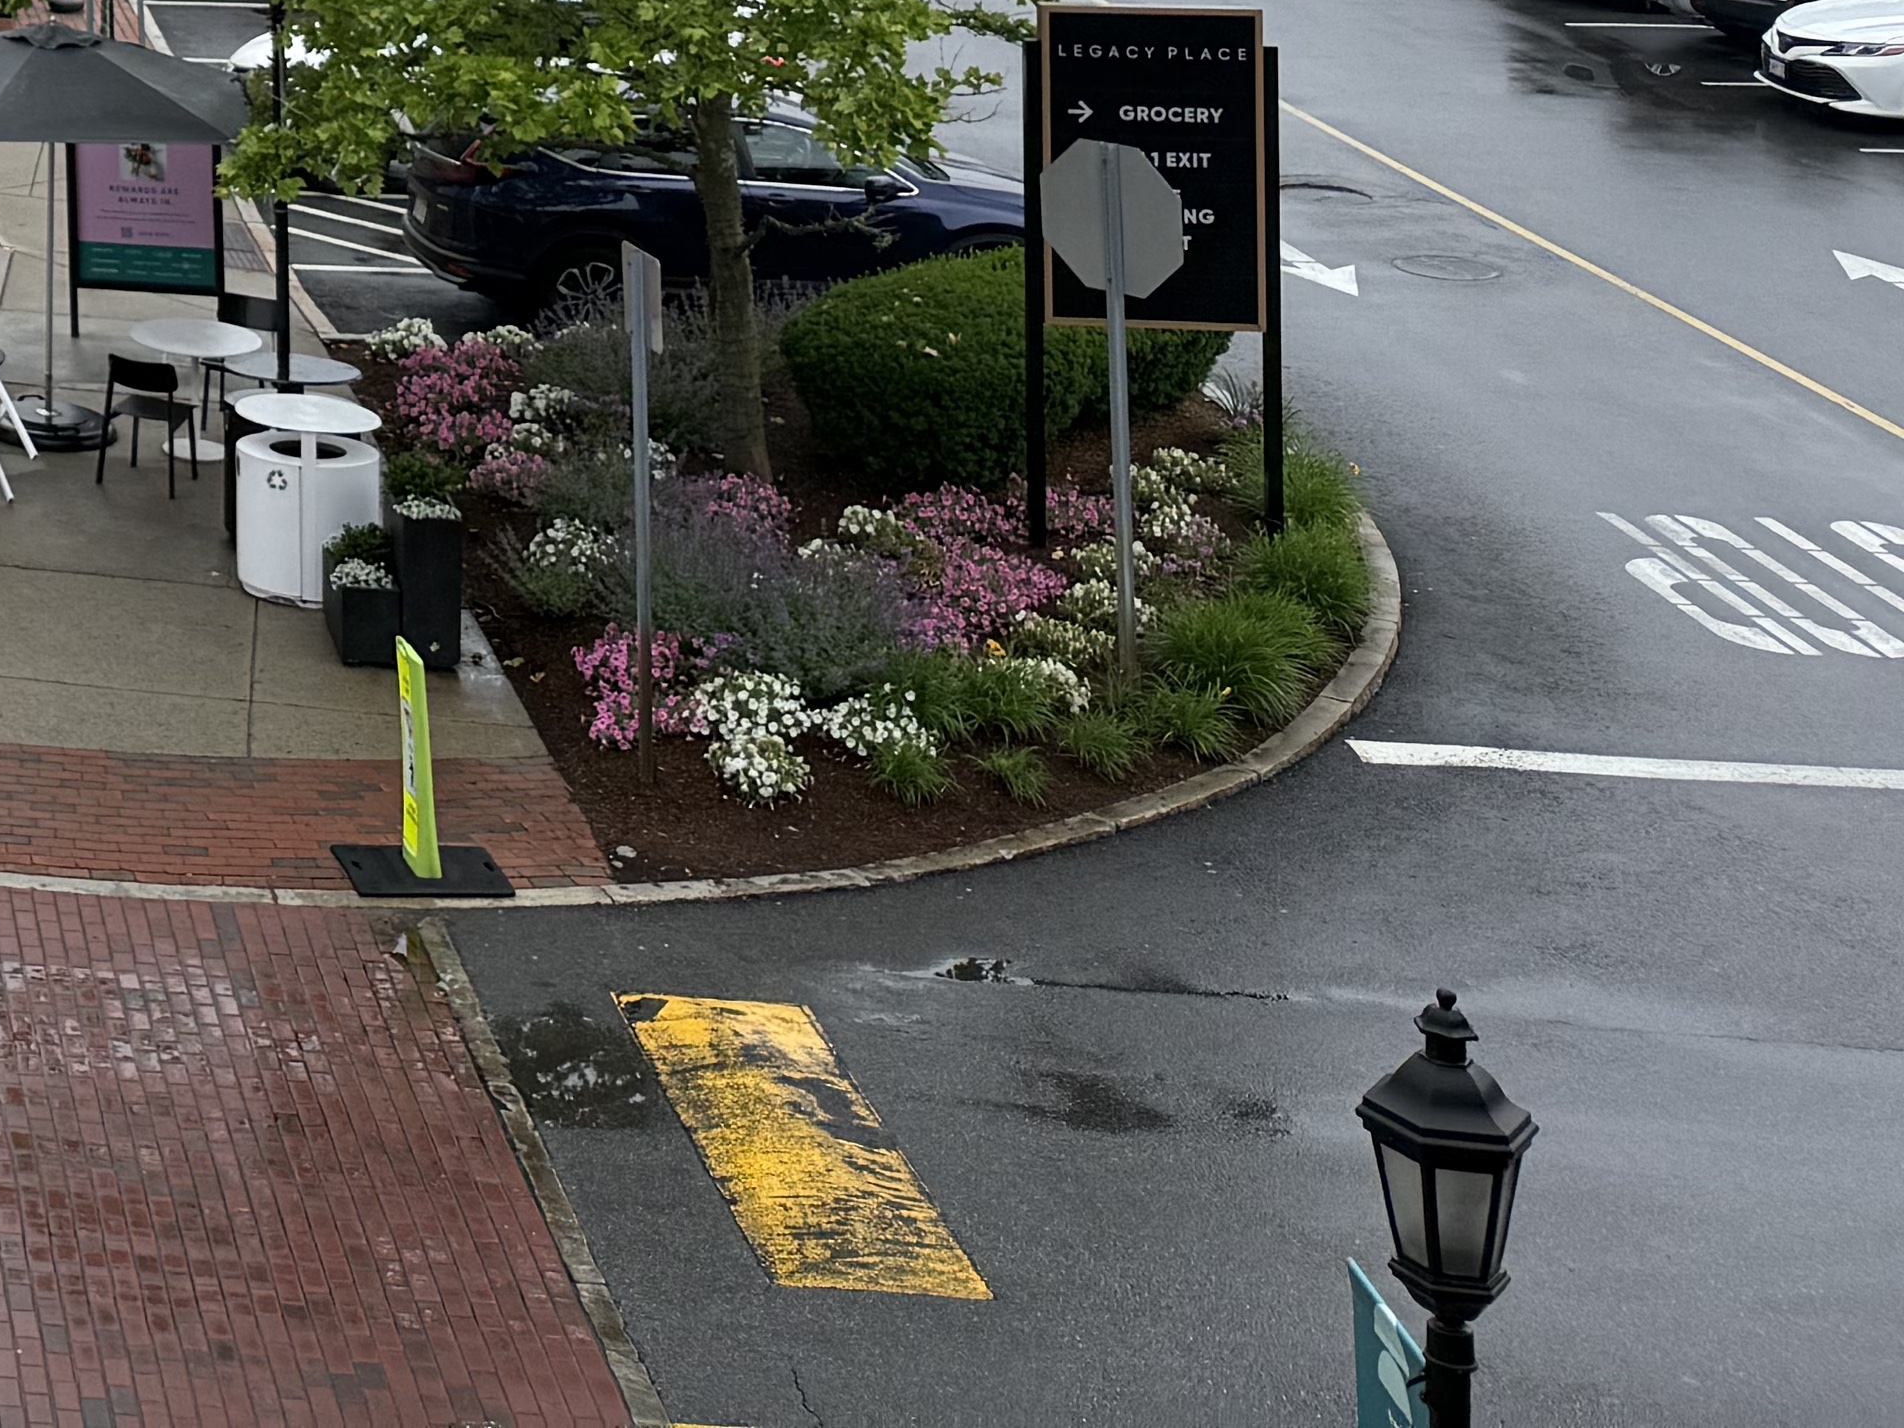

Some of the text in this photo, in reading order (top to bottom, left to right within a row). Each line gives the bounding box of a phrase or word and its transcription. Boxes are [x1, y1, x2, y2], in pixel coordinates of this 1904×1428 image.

[1058, 44, 1247, 61] LEGACY PLACE
[1119, 105, 1224, 123] GROCERY
[1166, 152, 1212, 168] EXIT
